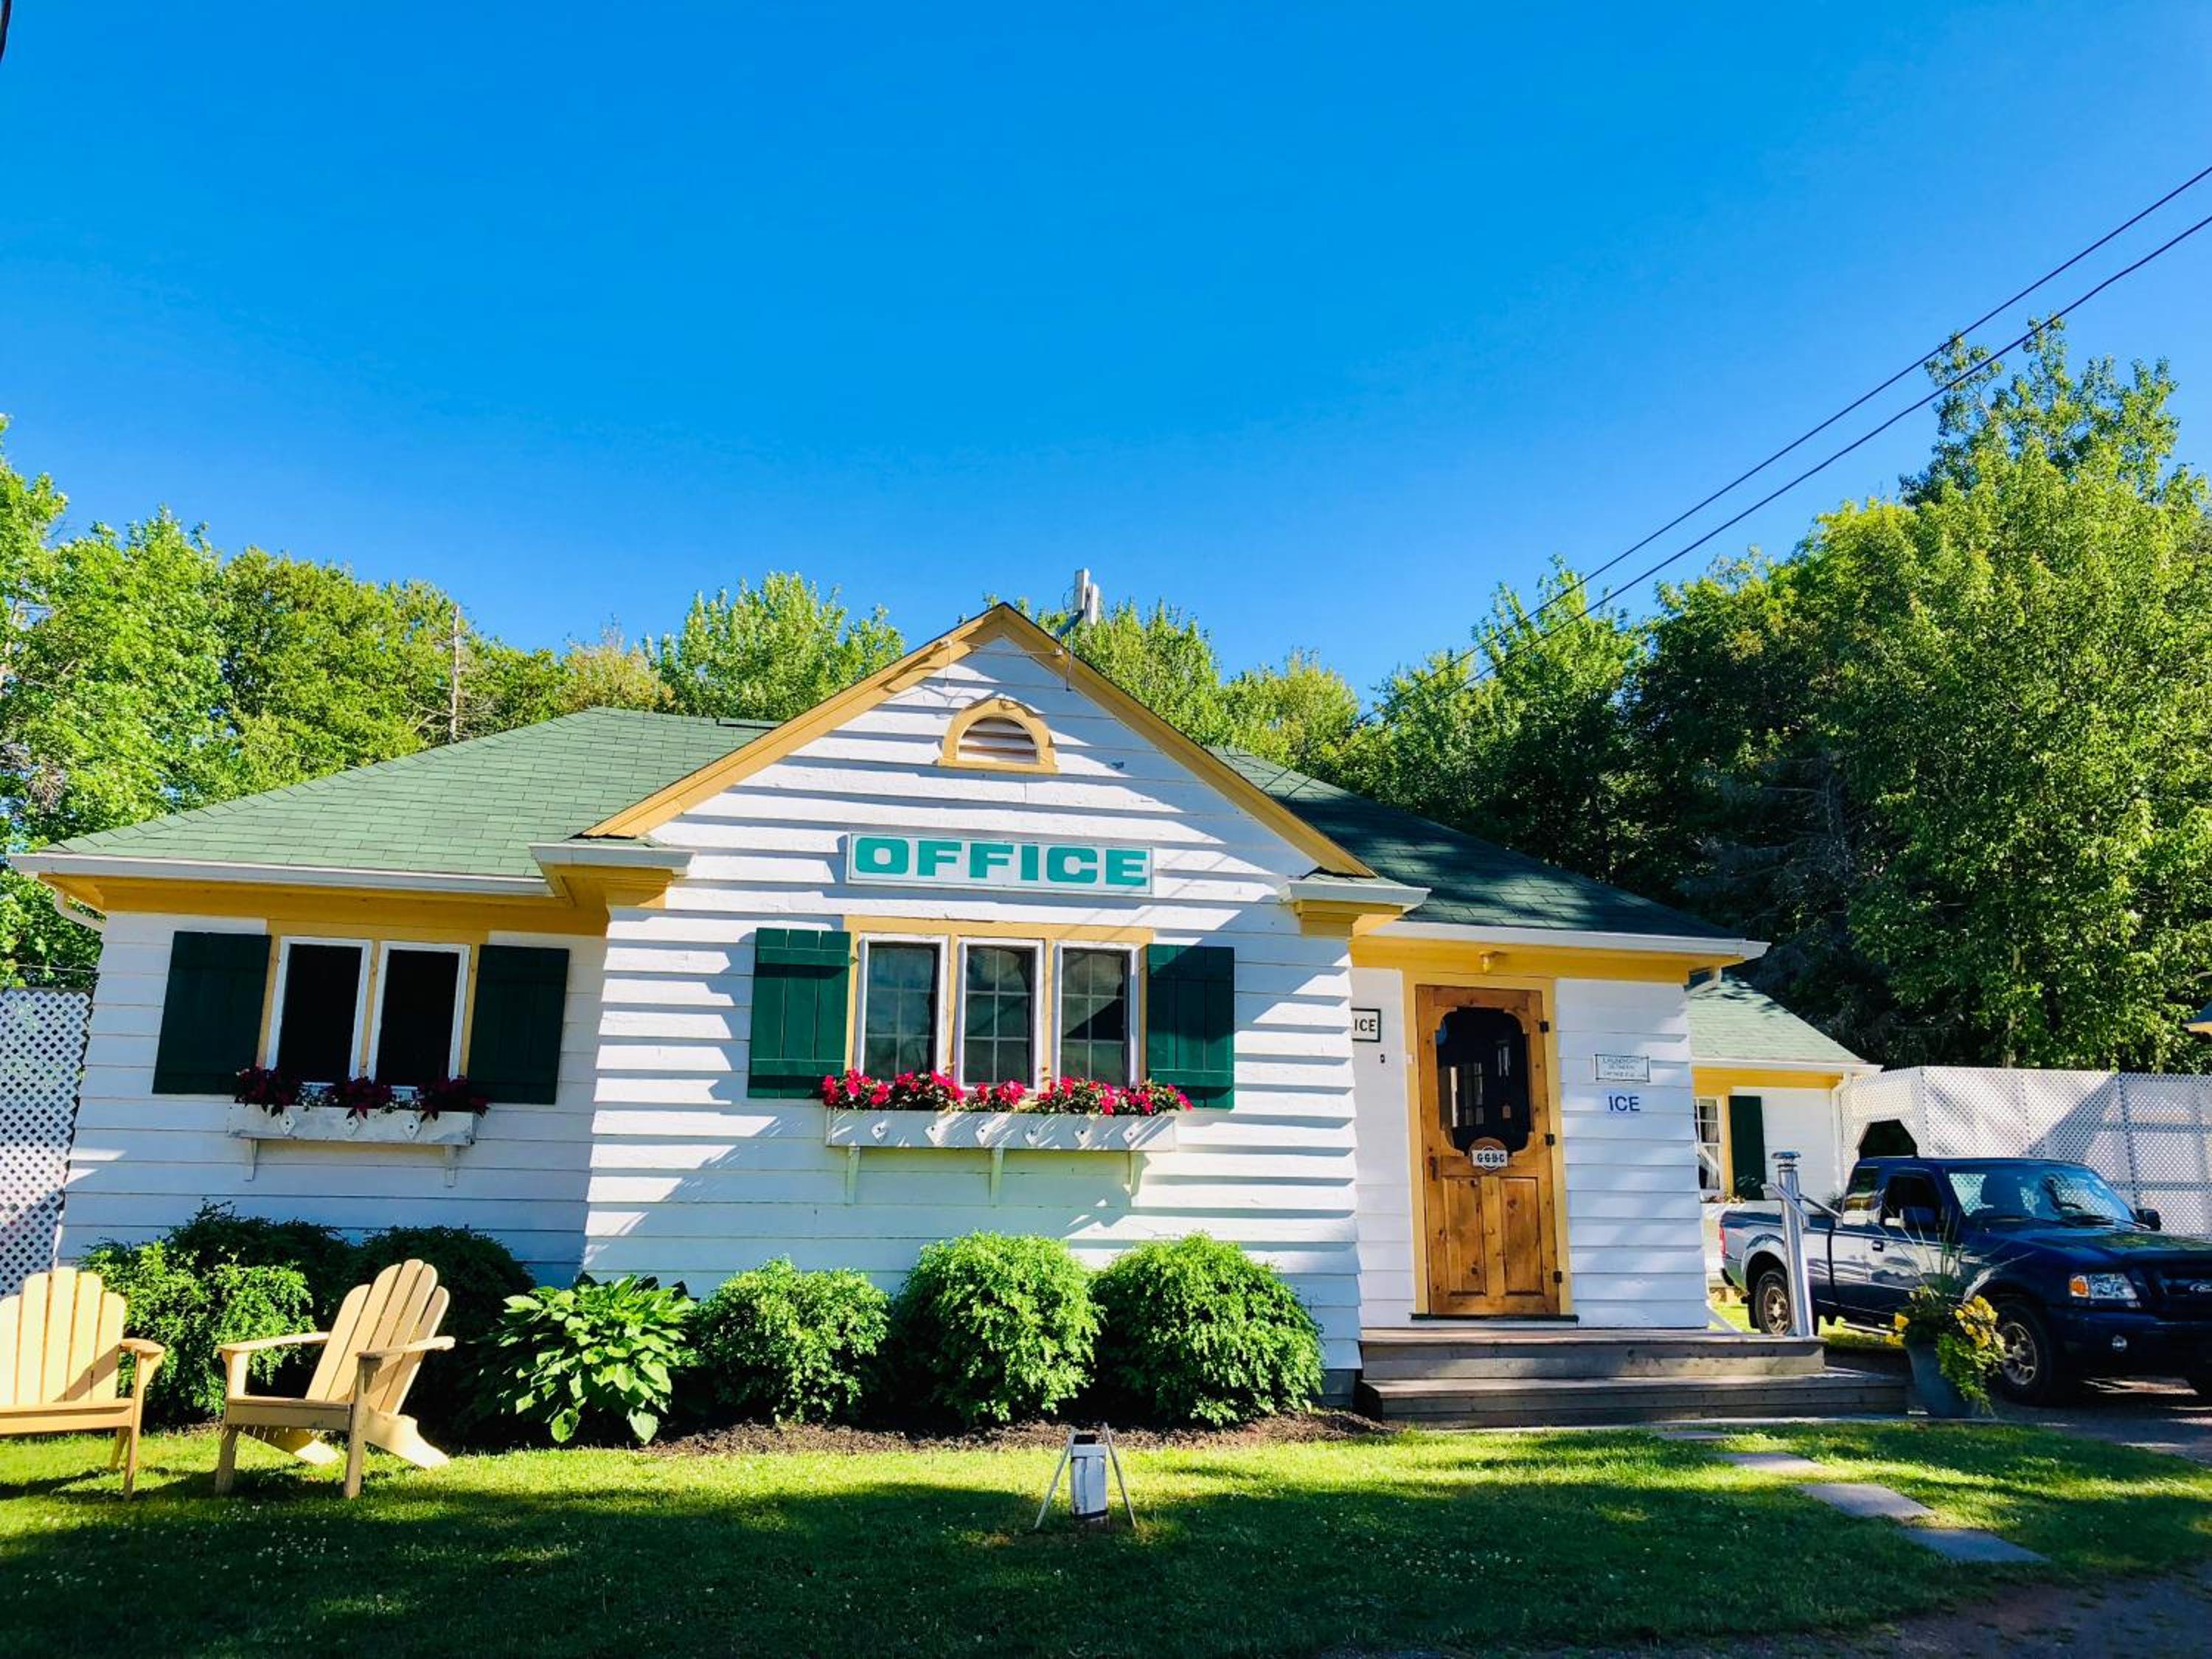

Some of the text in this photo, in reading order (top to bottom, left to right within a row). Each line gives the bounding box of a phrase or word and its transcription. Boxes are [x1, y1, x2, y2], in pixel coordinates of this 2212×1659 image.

[855, 837, 1147, 886] OFFICE
[1354, 1018, 1377, 1032] ICE
[1608, 1095, 1641, 1111] ICE
